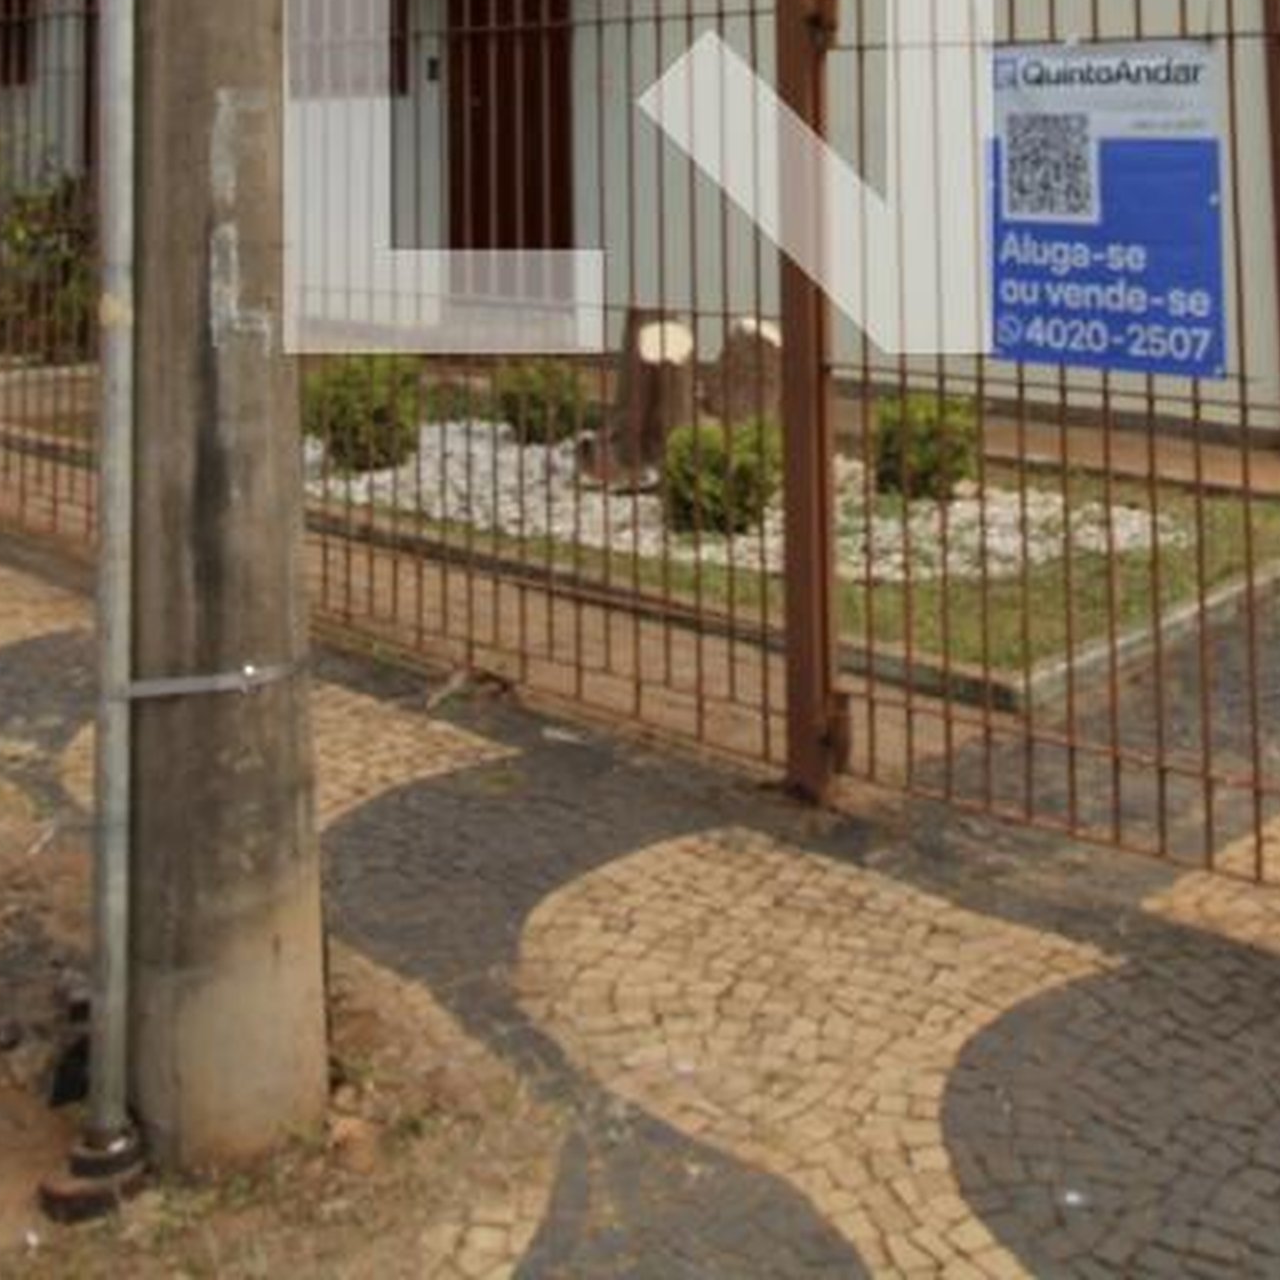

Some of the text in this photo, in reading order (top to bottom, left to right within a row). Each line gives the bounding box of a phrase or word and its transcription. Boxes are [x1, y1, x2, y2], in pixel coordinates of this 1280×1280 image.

[1022, 58, 1204, 86] QuintoAndar
[1000, 232, 1147, 274] Aluga-se
[1000, 279, 1210, 318] ou vende-se
[1026, 318, 1212, 360] 4020-2507
